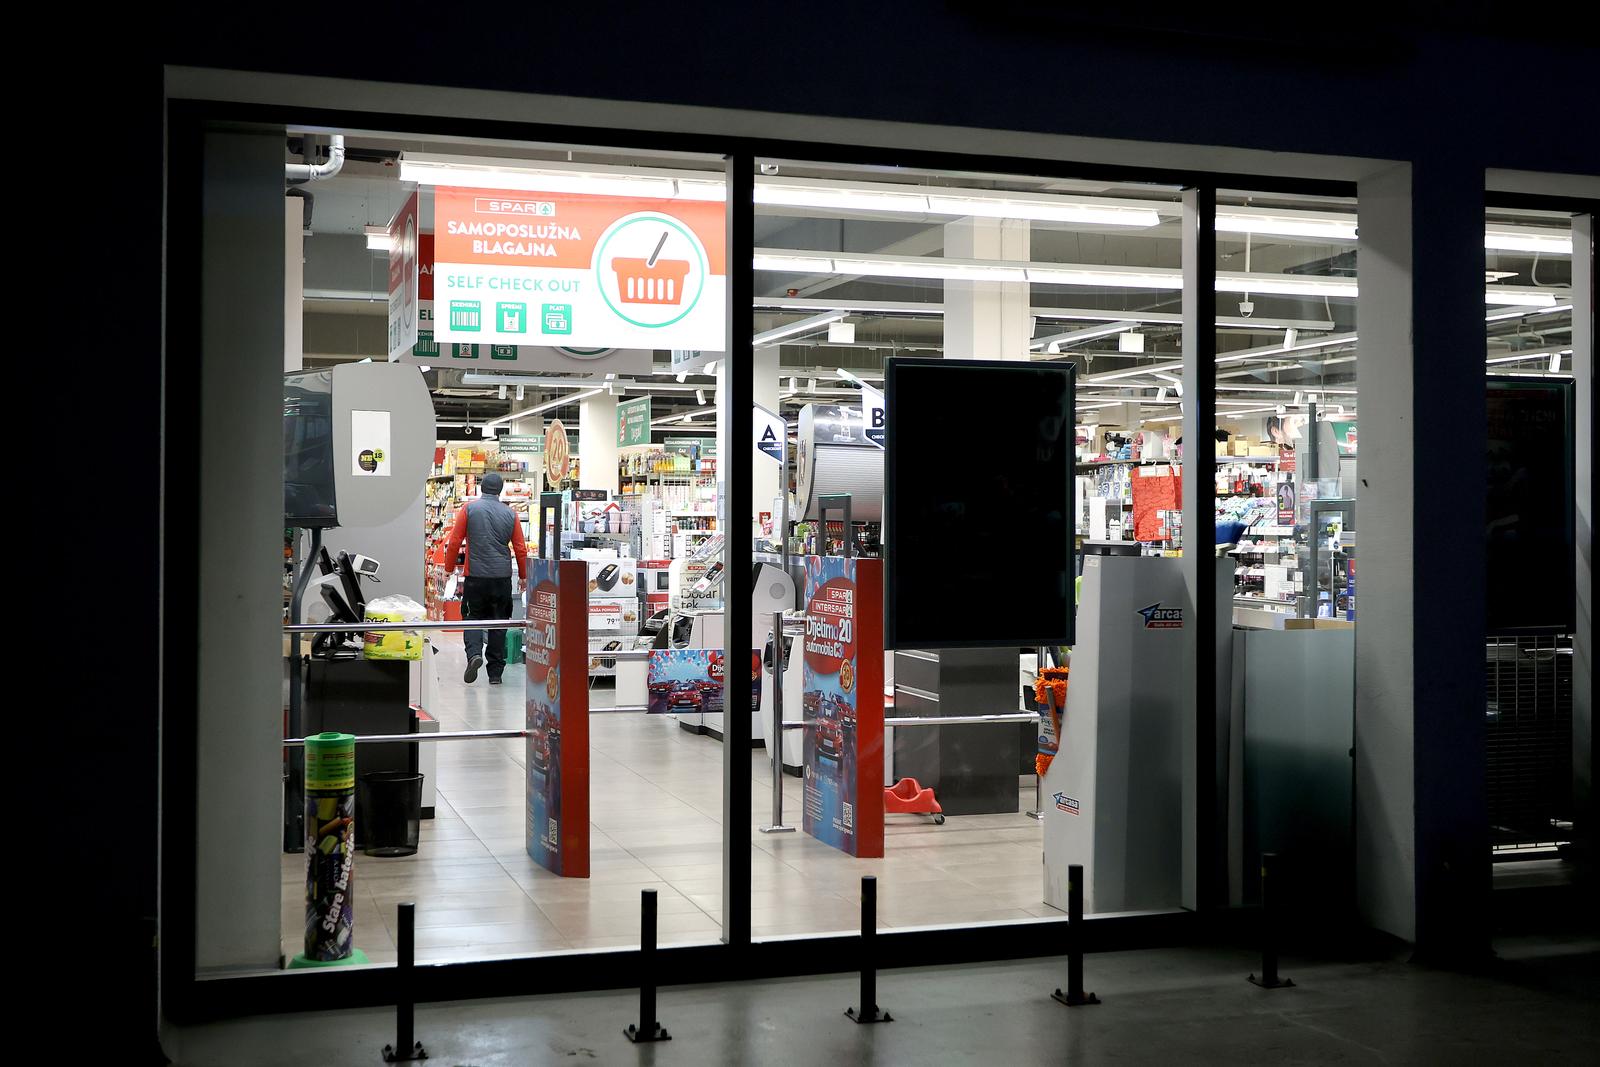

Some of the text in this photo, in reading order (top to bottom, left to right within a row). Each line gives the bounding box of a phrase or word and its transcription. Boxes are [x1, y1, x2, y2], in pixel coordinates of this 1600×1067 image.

[489, 201, 535, 214] SPAR
[447, 220, 582, 240] SAMOPOSLUŽNA
[473, 239, 557, 257] BLAGAJNA
[447, 275, 580, 292] SELF CHECK OUT
[871, 407, 885, 428] B
[761, 424, 777, 441] A
[831, 590, 846, 600] SPAR
[681, 599, 698, 609] tek
[815, 602, 847, 614] INTERSPAR
[806, 615, 853, 643] Dijelimo 20
[806, 640, 834, 657] automobila
[322, 893, 345, 933] Stare
